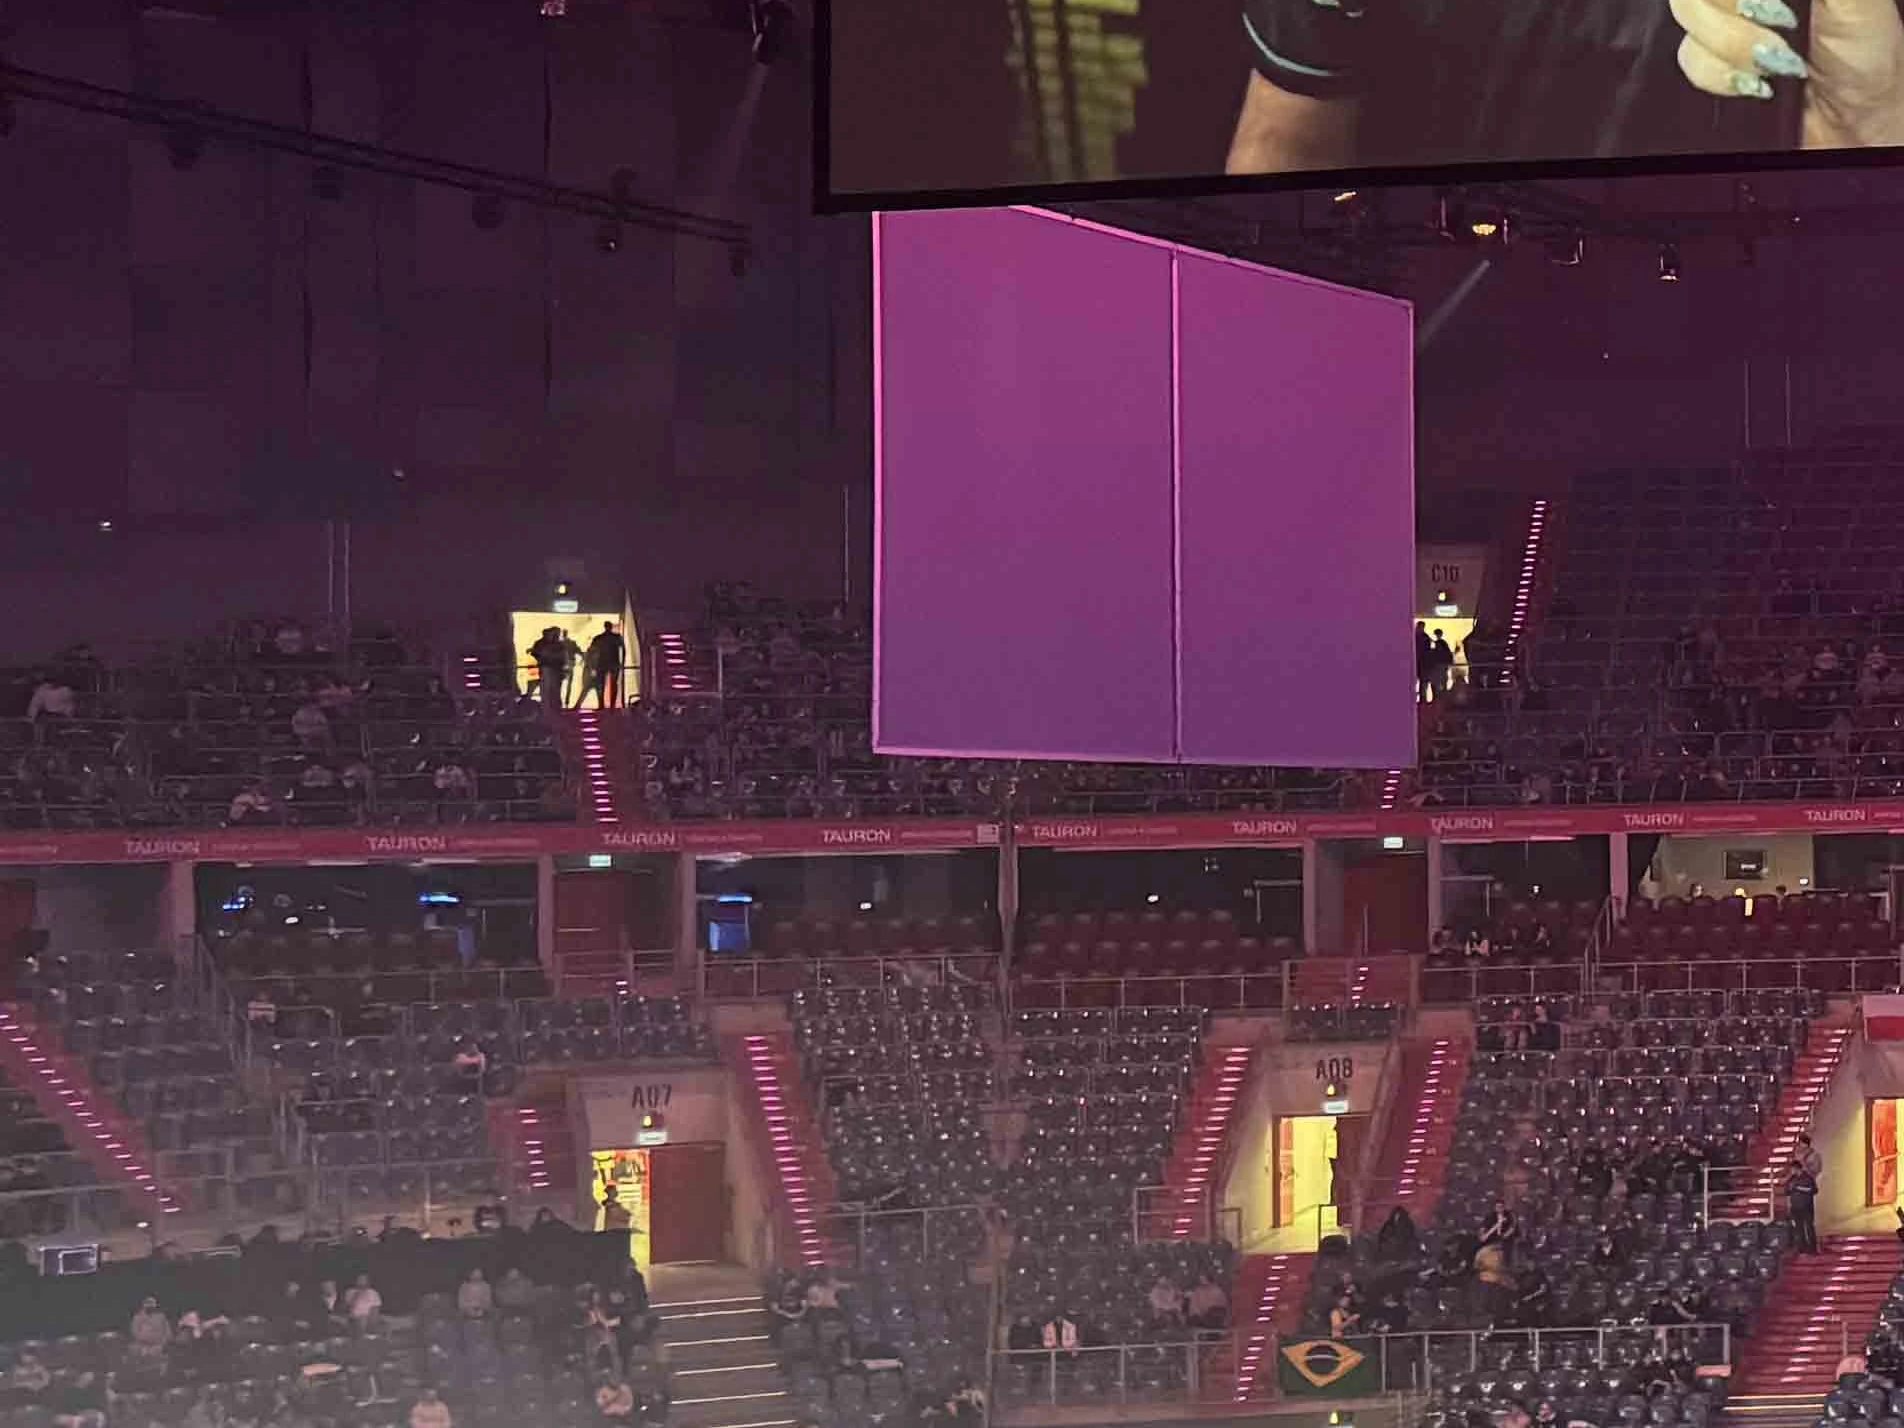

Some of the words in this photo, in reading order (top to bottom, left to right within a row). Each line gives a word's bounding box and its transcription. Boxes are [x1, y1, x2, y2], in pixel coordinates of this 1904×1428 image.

[1624, 813, 1684, 827] TAURON
[1806, 810, 1866, 823] TAURON
[1032, 824, 1097, 839] TAURON
[1232, 820, 1297, 836] TAURON
[1431, 817, 1493, 832] TAURON
[602, 832, 676, 847] TAURON
[822, 828, 891, 844] TAURON
[366, 836, 447, 853] TAURON
[1316, 1058, 1352, 1079] A08
[632, 1084, 672, 1108] A07
